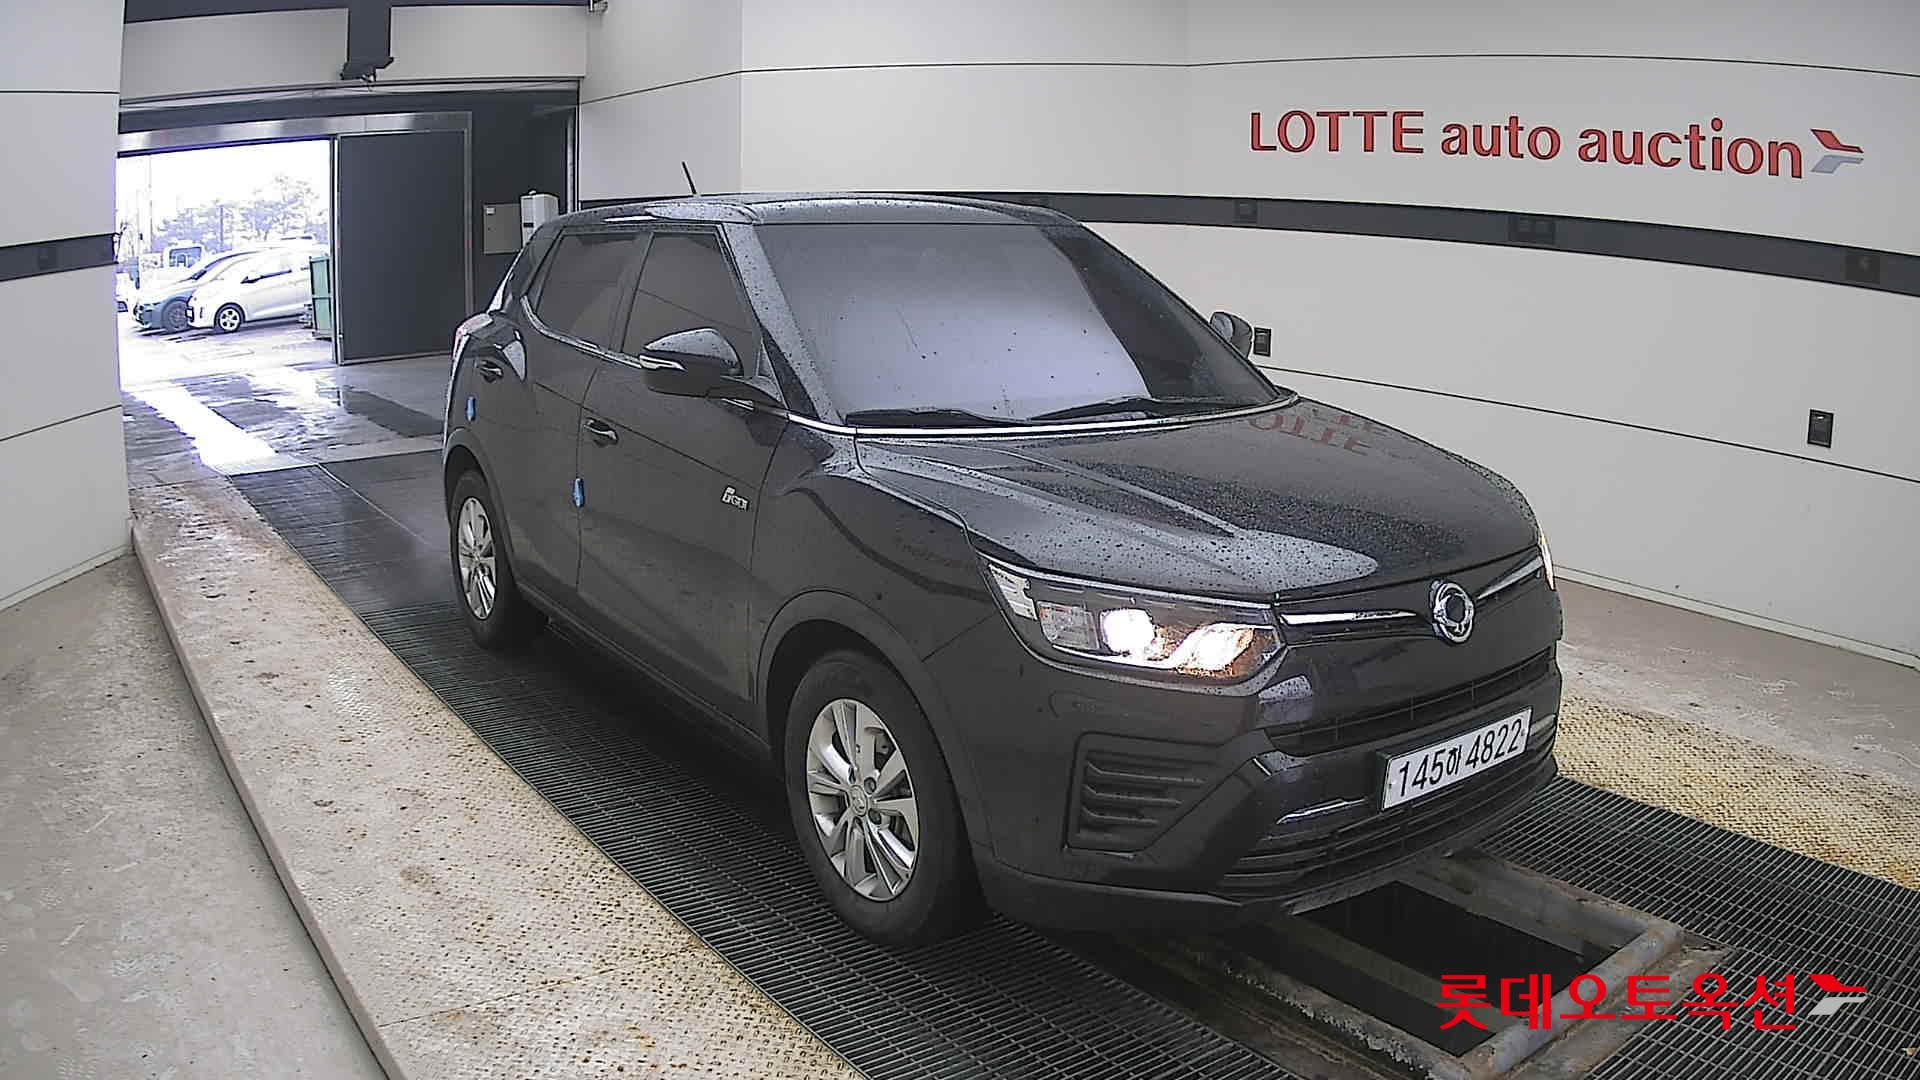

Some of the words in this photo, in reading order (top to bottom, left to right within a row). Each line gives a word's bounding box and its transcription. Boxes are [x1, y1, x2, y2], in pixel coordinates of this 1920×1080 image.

[1250, 110, 1425, 154] LOTTE
[1440, 114, 1562, 161] auto
[1576, 117, 1804, 179] auction
[1465, 718, 1522, 769] 4822
